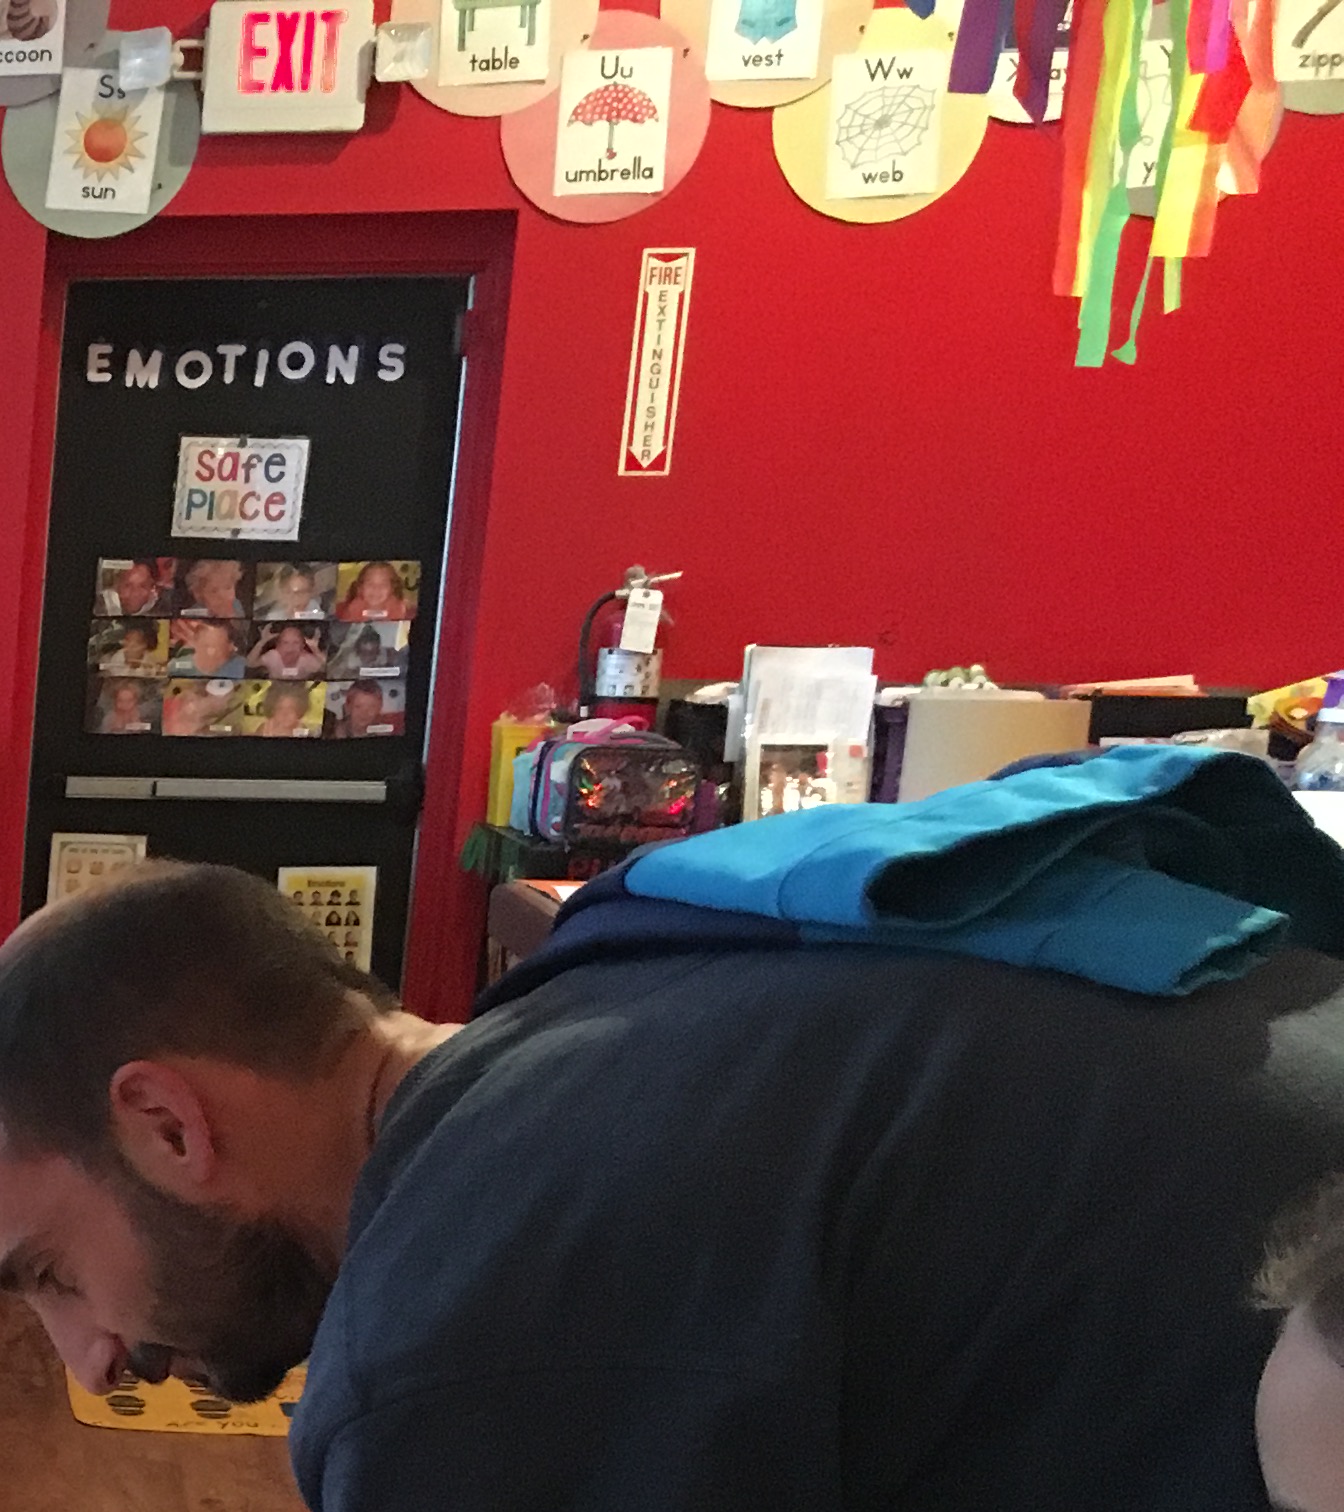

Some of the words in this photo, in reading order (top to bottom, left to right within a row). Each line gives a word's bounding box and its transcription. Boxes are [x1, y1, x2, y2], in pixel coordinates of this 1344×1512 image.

[237, 9, 348, 95] EXIT
[469, 50, 520, 72] table
[741, 49, 784, 68] vest
[599, 56, 634, 81] Uu
[865, 56, 914, 82] Ww
[98, 76, 126, 101] Ss
[564, 159, 655, 183] umbrella
[861, 163, 904, 186] web
[80, 184, 116, 202] sun
[649, 267, 683, 286] FIRE
[87, 340, 406, 390] EMOTIONS
[640, 290, 669, 461] EXTINGUISHER
